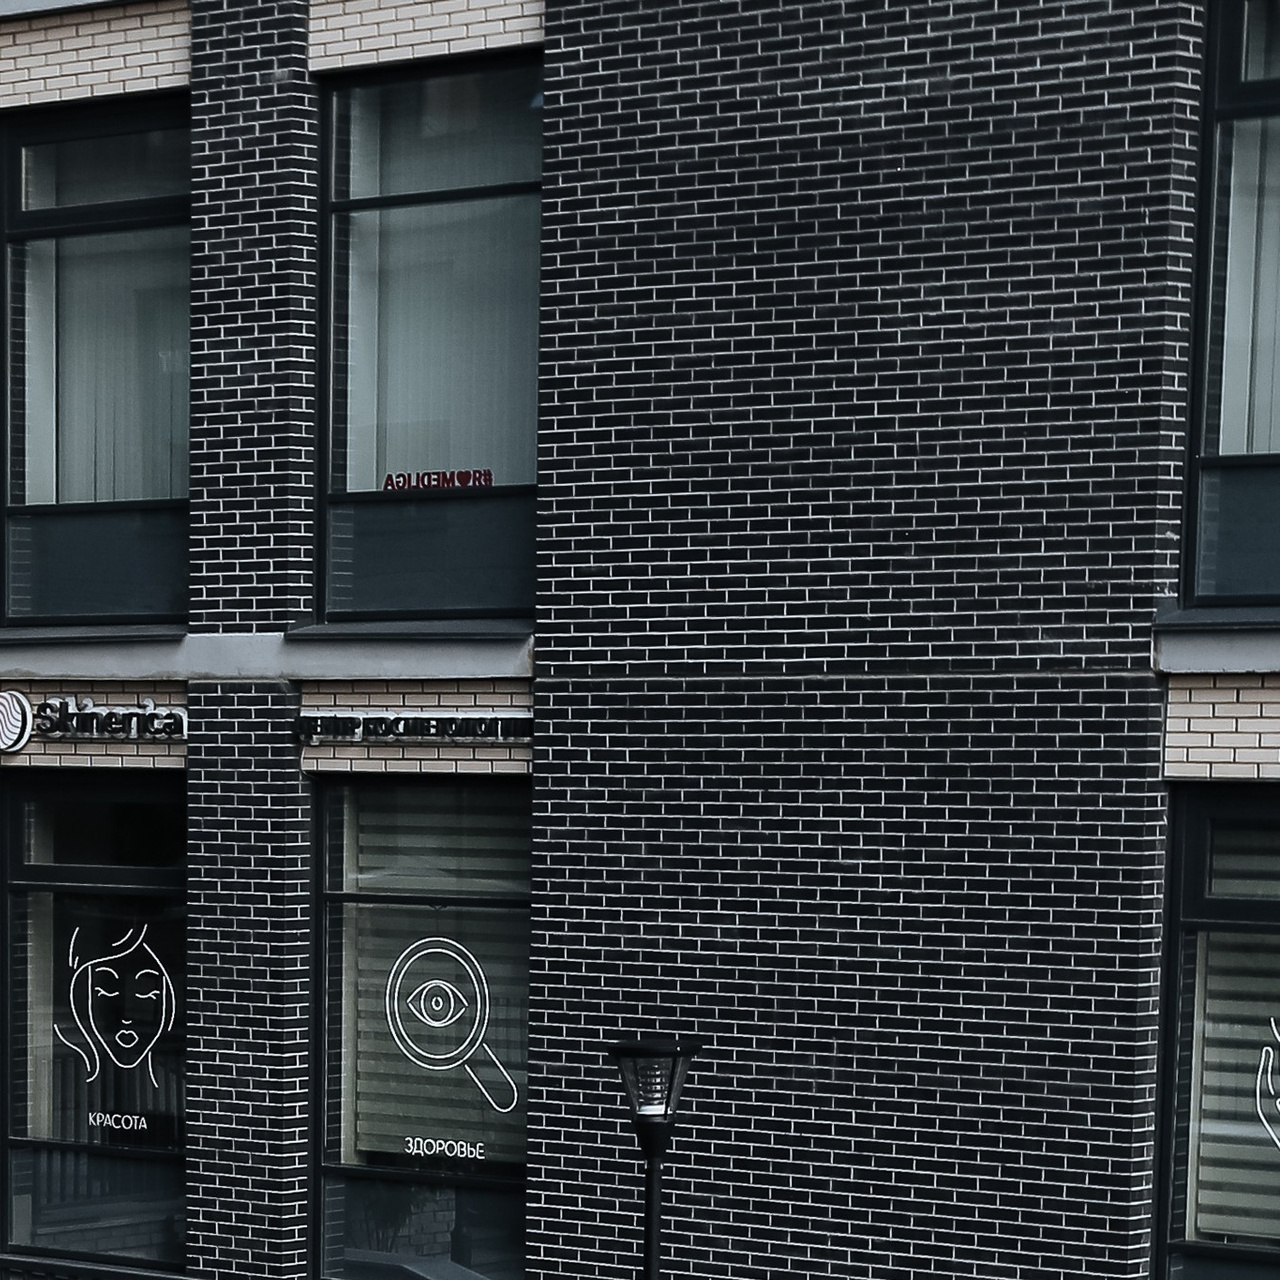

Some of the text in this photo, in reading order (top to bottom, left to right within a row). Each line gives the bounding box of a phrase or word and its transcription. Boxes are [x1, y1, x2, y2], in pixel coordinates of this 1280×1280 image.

[35, 696, 188, 739] Skinerica
[88, 1112, 148, 1130] КРАСОТА
[404, 1137, 486, 1160] ЗДОРОВЬЕ
